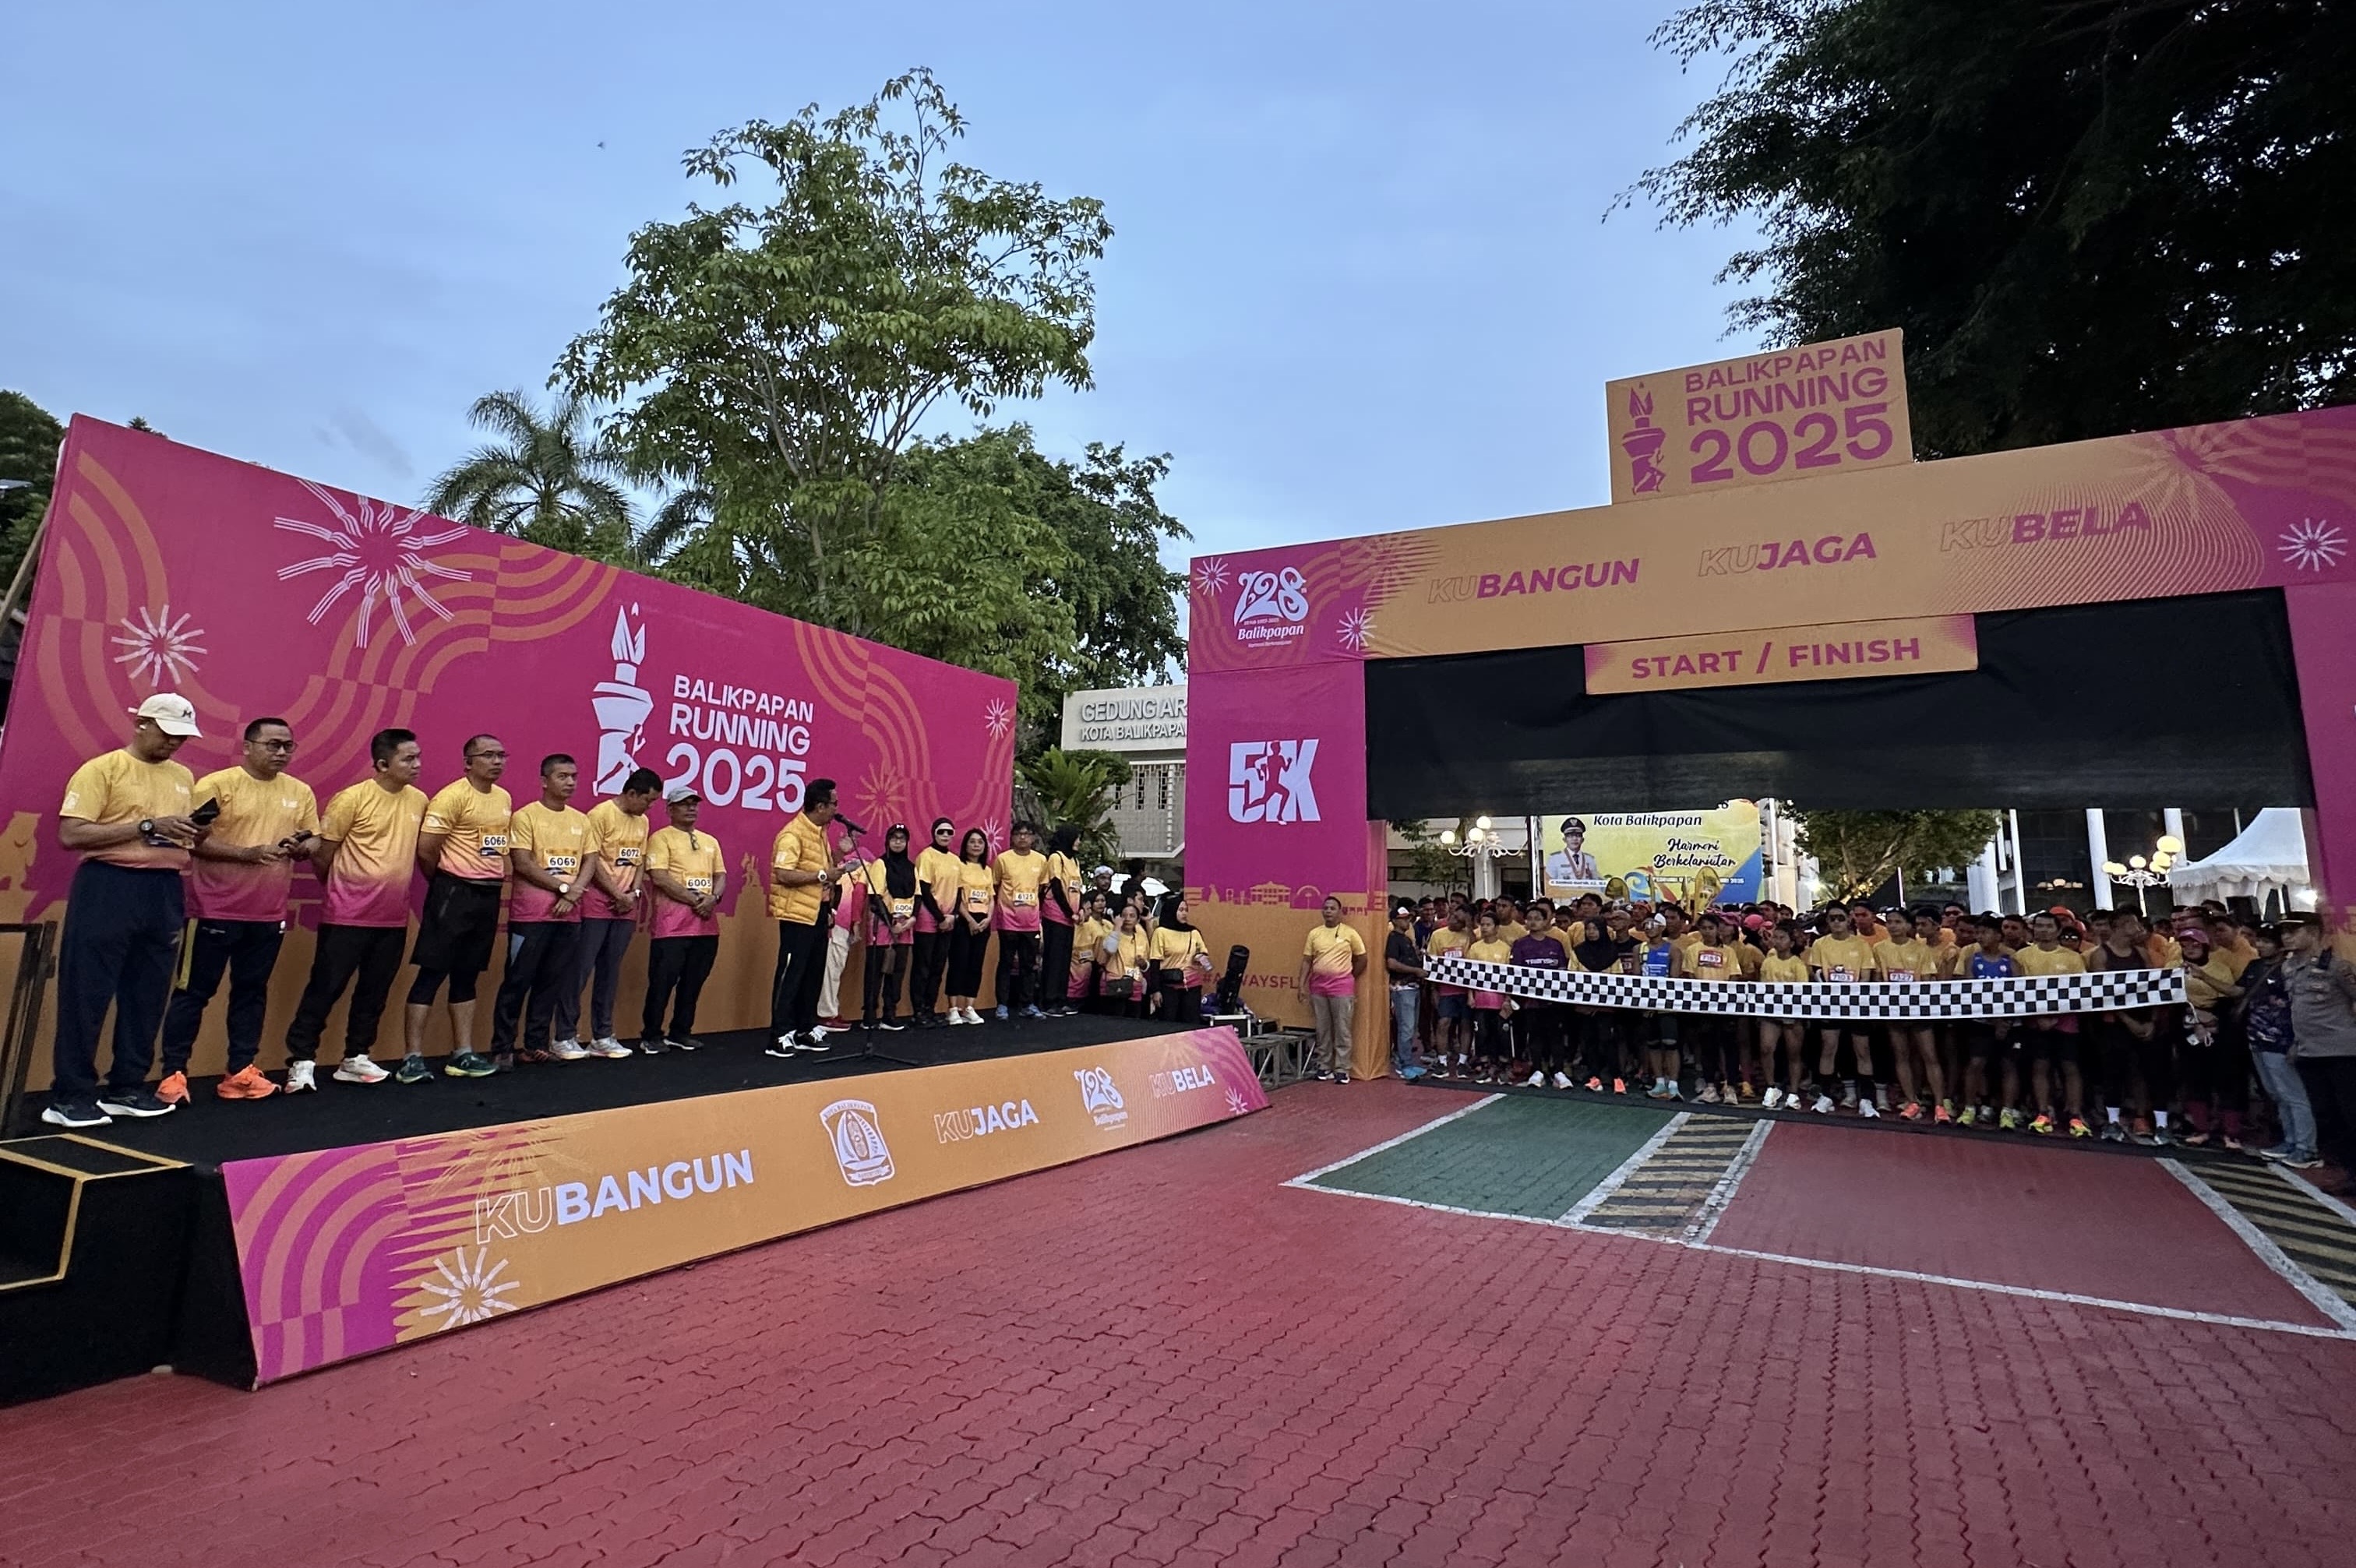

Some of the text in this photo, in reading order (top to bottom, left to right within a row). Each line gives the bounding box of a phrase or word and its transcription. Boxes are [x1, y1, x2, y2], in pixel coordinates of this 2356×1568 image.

[1685, 338, 1886, 393] BALIKPAPAN
[1687, 367, 1888, 426] RUNNING
[1689, 402, 1893, 484] 2025
[1940, 500, 2151, 551] KUBELA
[1697, 532, 1877, 577] KUJAGA
[1428, 558, 1640, 604] KUBANGUN
[1237, 625, 1304, 640] Balikpapan
[1631, 637, 1920, 679] START / FINISH
[673, 674, 813, 724] BALIKPAPAN
[1081, 697, 1187, 722] GEDUNG AR
[669, 703, 810, 756] RUNNING
[1081, 722, 1187, 742] KOTA BALIKPAPA
[662, 742, 806, 813] 2025
[1229, 738, 1321, 823] 5K
[484, 837, 506, 846] 6066
[1593, 815, 1702, 828] Kota Balikpapan
[549, 857, 576, 866] 6069
[1667, 837, 1720, 853] Harmoni
[1149, 1065, 1215, 1099] KUBELA
[934, 1099, 1039, 1143] KUJAGA
[475, 1149, 754, 1245] KUBANGUN
